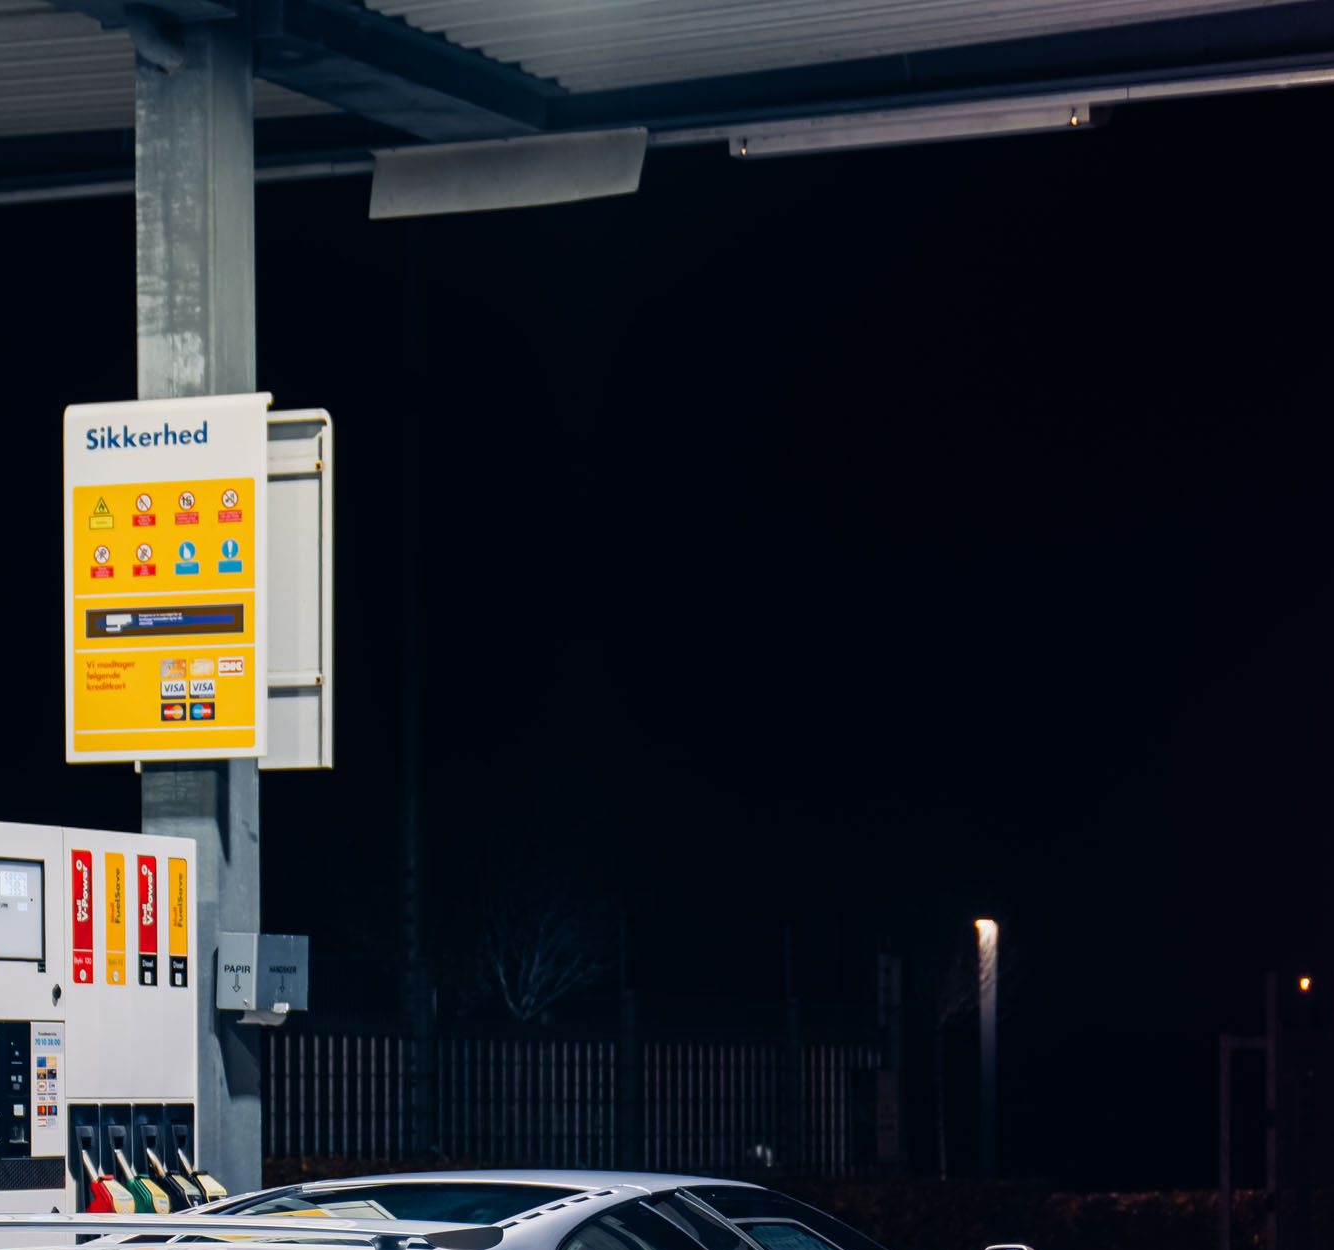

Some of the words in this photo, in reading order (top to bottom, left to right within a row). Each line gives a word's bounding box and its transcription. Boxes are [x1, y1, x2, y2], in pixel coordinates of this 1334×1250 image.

[85, 420, 209, 451] Sikkerhed
[164, 683, 185, 692] VISA
[192, 682, 214, 692] VISA
[224, 964, 251, 974] PAPIR
